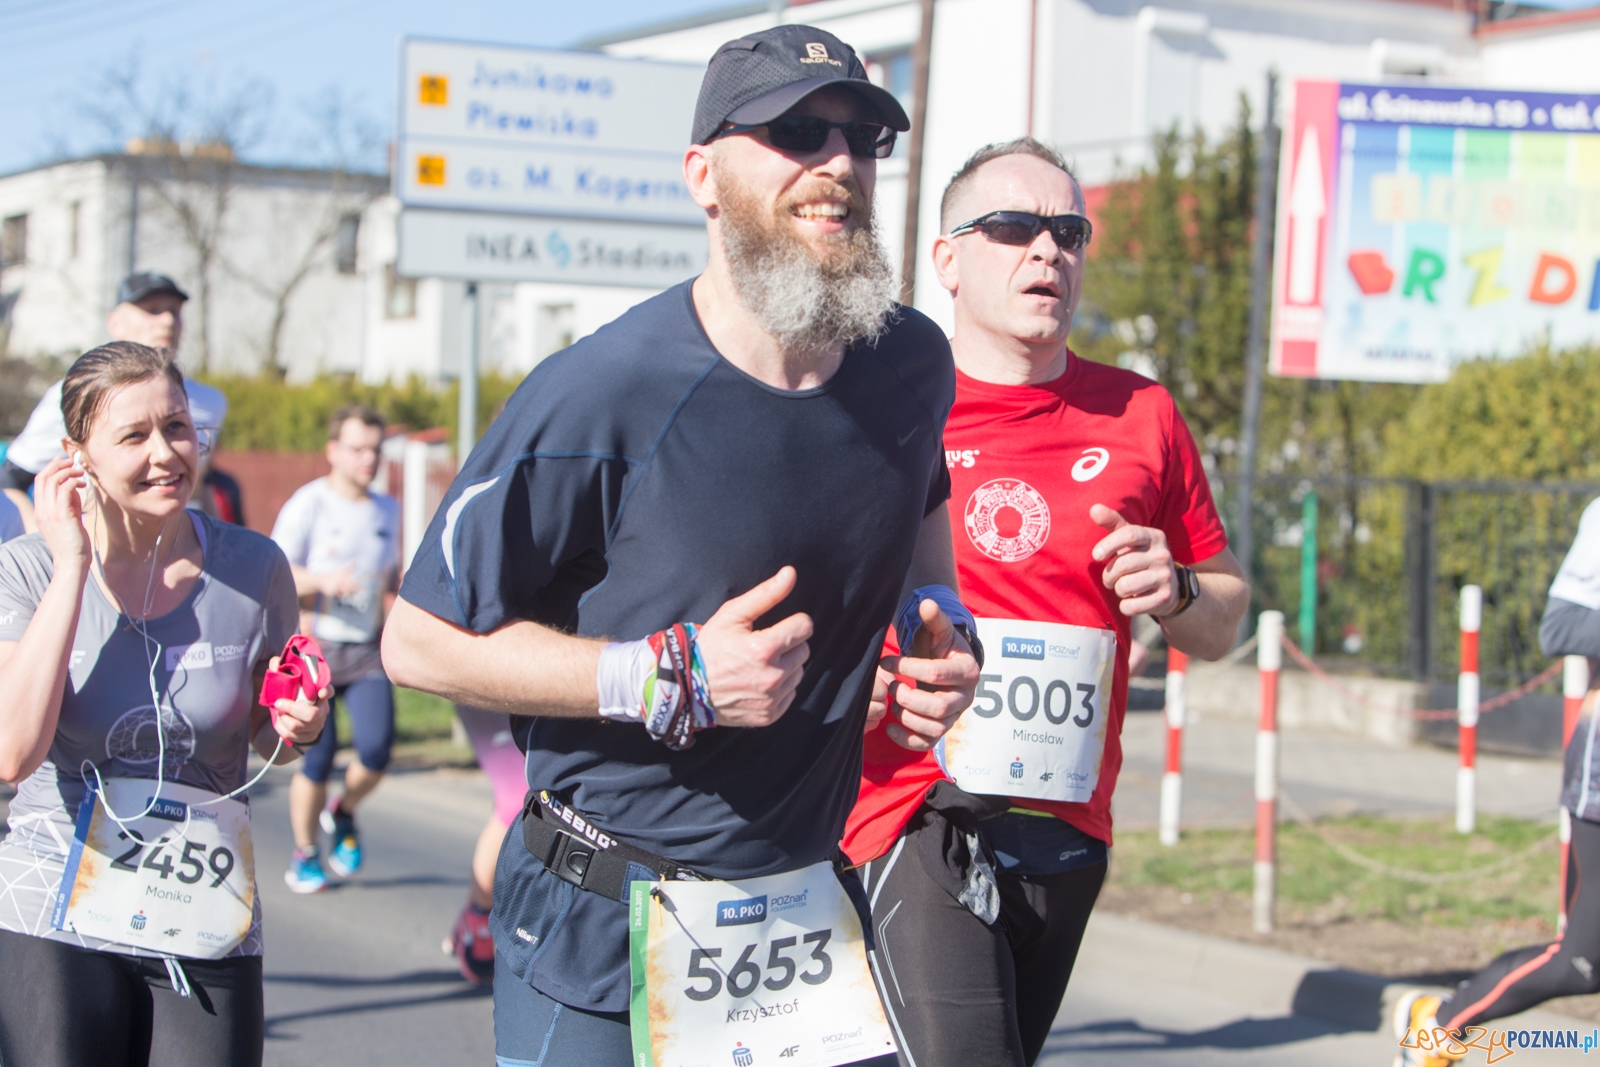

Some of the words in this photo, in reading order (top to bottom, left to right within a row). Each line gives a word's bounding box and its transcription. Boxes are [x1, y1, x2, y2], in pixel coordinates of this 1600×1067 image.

[470, 62, 615, 99] Junikowo
[466, 232, 541, 264] INEA
[577, 237, 694, 270] Stadion
[1020, 643, 1042, 655] PKO
[972, 674, 1096, 728] 5003
[1013, 729, 1064, 746] Mirosław
[110, 830, 234, 888] 2459
[145, 885, 192, 904] Monika
[722, 907, 738, 919] 10.
[740, 903, 764, 918] PKO
[684, 928, 833, 1002] 5653
[726, 998, 799, 1023] Krzysztof
